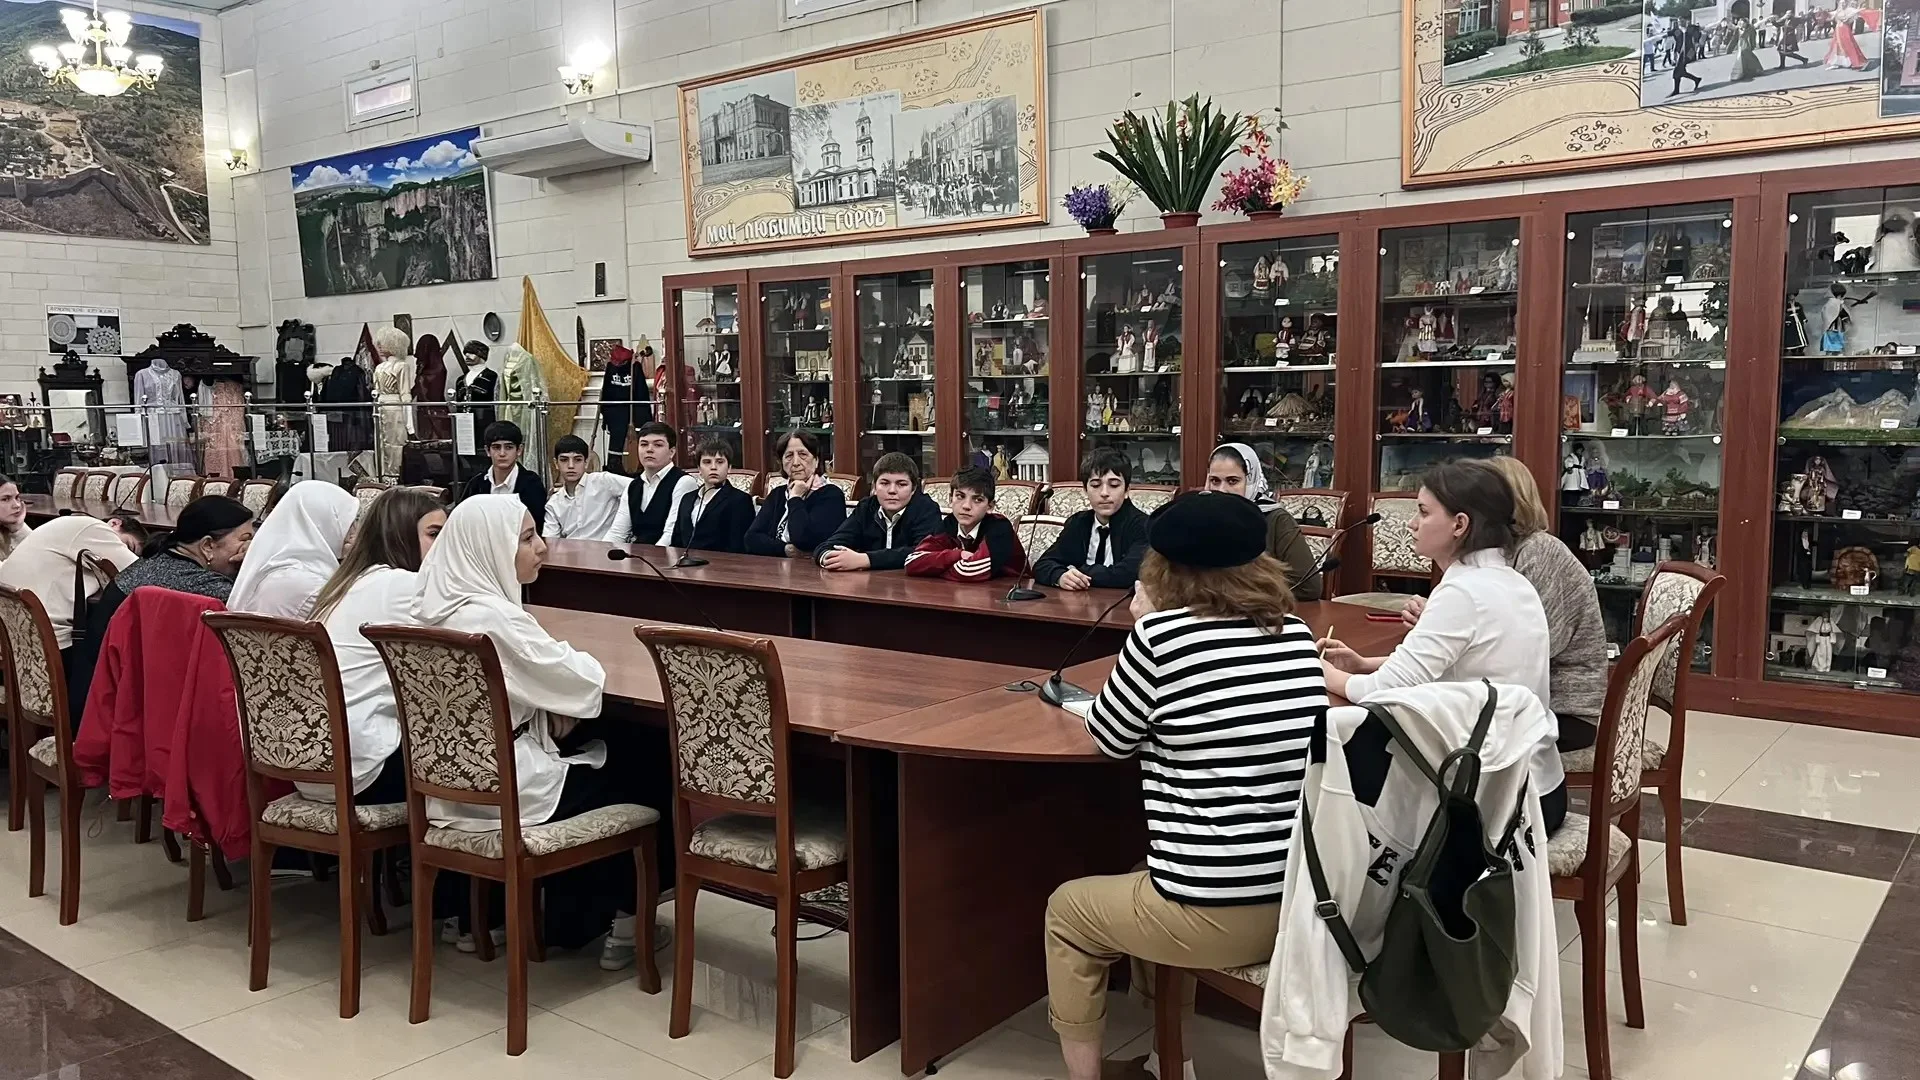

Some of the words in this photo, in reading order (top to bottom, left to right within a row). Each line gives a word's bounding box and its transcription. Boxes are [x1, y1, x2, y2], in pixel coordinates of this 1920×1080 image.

[706, 220, 737, 243] МОЙ
[743, 211, 827, 241] ЛЮБИМЫЙ
[835, 207, 887, 231] ГОРОД
